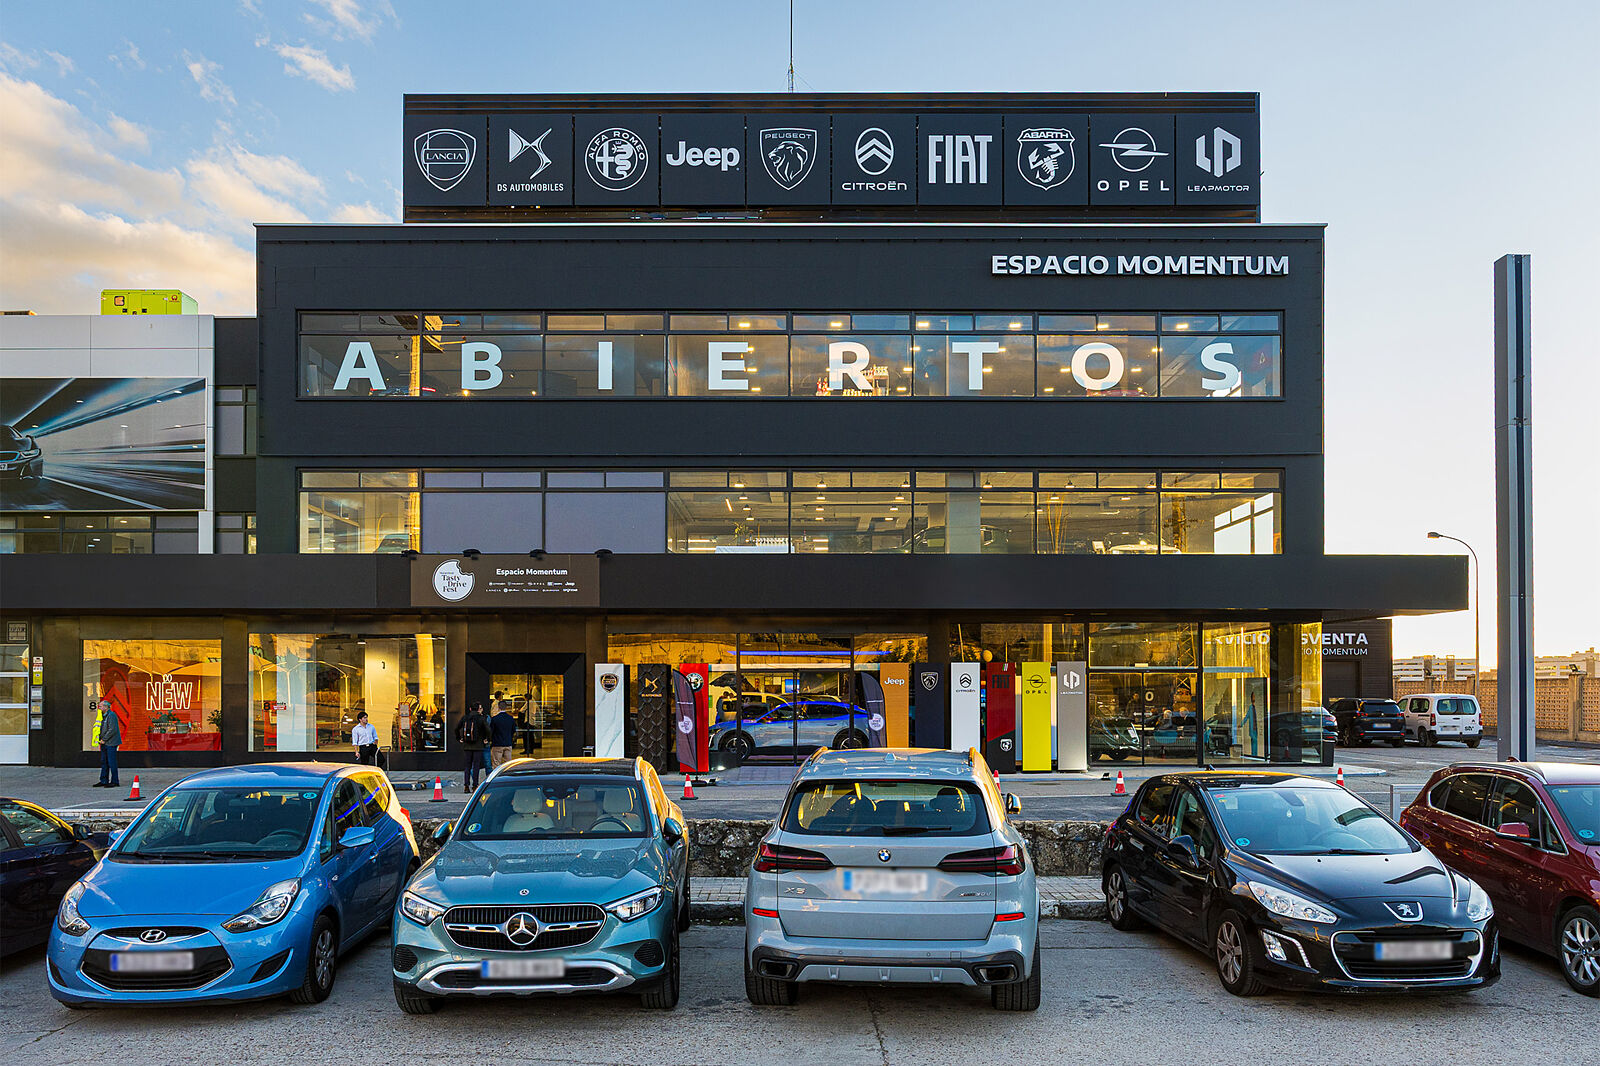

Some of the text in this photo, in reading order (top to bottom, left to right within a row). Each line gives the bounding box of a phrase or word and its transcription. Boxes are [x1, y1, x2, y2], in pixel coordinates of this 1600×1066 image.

[1022, 131, 1069, 139] ABARTH
[588, 130, 646, 161] ALFA ROMEO
[426, 152, 464, 160] LANCIA
[665, 140, 740, 171] Jeep
[928, 135, 993, 184] FIAT
[497, 183, 564, 192] DS AUTOMOBILES
[1097, 180, 1170, 191] OPEL
[991, 255, 1290, 275] ESPACIO MOMENTUM
[496, 568, 525, 577] Espacio
[441, 574, 461, 582] Tasty
[884, 677, 905, 686] Jeep
